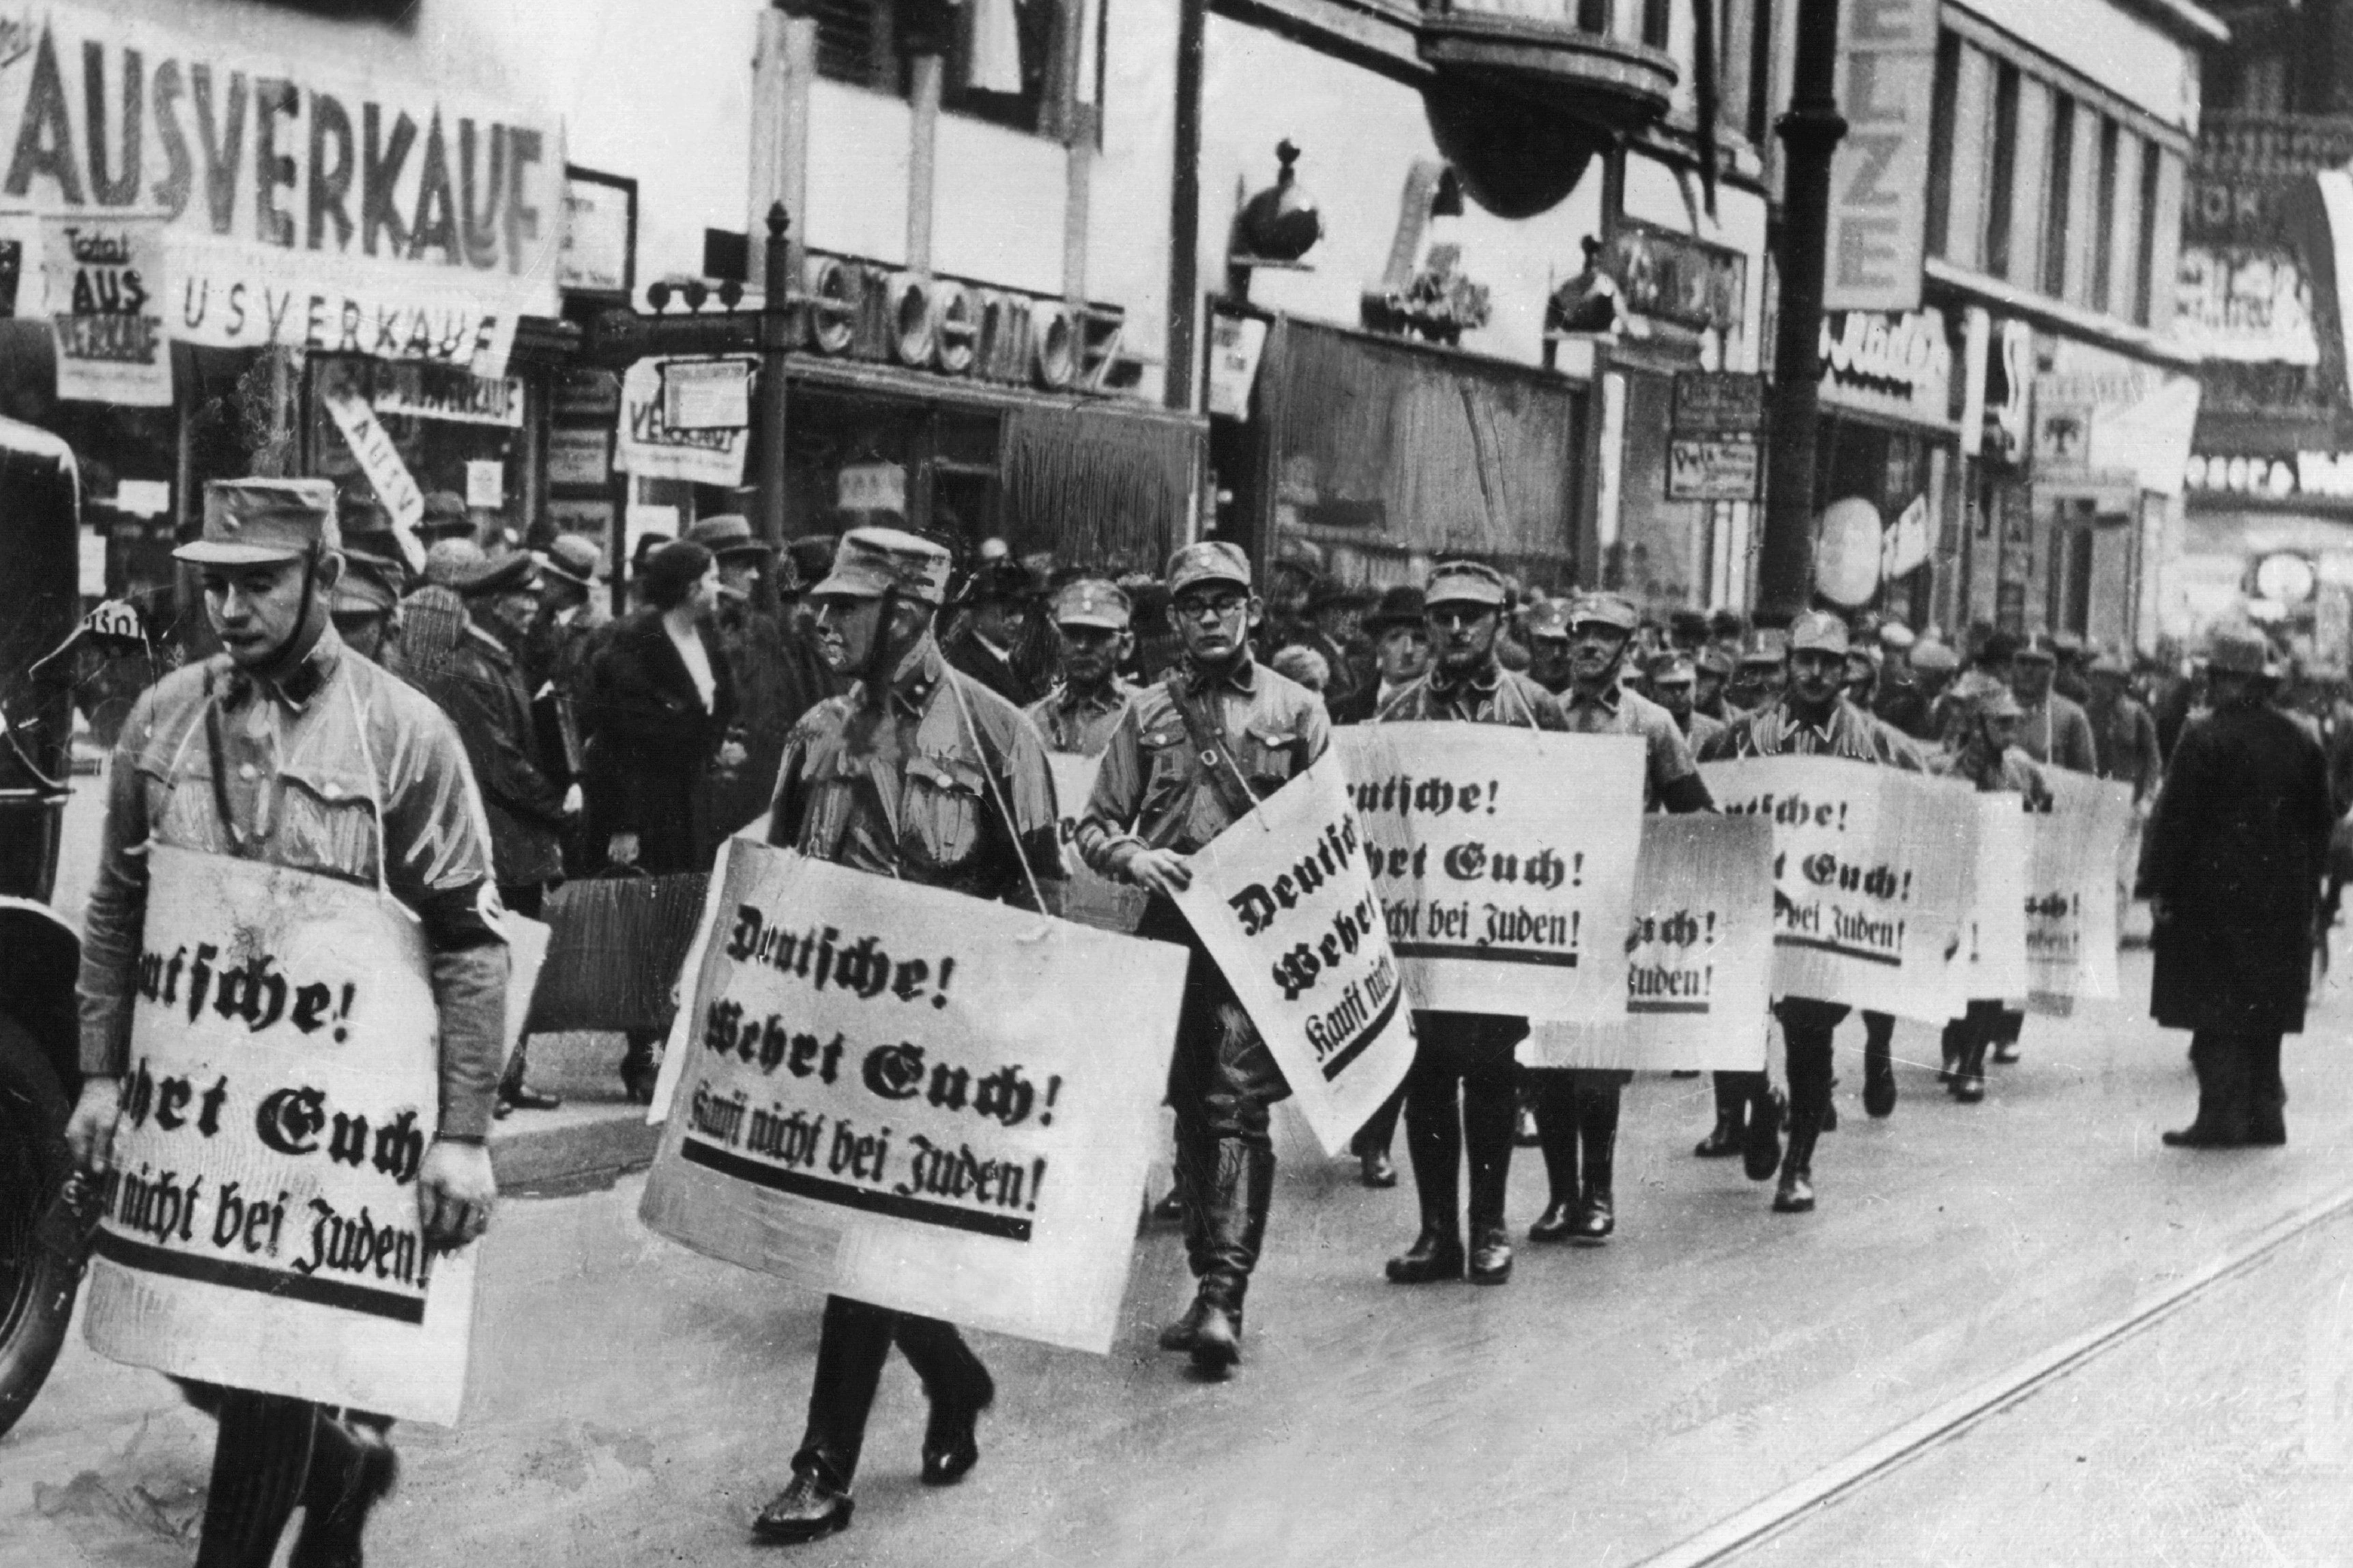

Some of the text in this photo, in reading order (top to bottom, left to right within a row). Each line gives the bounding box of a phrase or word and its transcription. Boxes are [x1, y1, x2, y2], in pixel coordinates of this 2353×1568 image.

[3, 19, 544, 276] AUSVERKAUF
[64, 226, 130, 265] Total
[72, 269, 151, 316] AUS
[1444, 841, 1584, 891] Euch!
[1802, 853, 1911, 902] Euch!
[1428, 900, 1469, 940] bei
[1477, 902, 1581, 947] Juden!
[1830, 904, 1905, 953] Juden!
[727, 903, 955, 1009] Deutsche!
[862, 1041, 1062, 1127] Euch!
[747, 1101, 825, 1168] nicht
[828, 1118, 892, 1183] bei
[893, 1134, 1047, 1212] Juden!
[212, 1181, 289, 1254] bei
